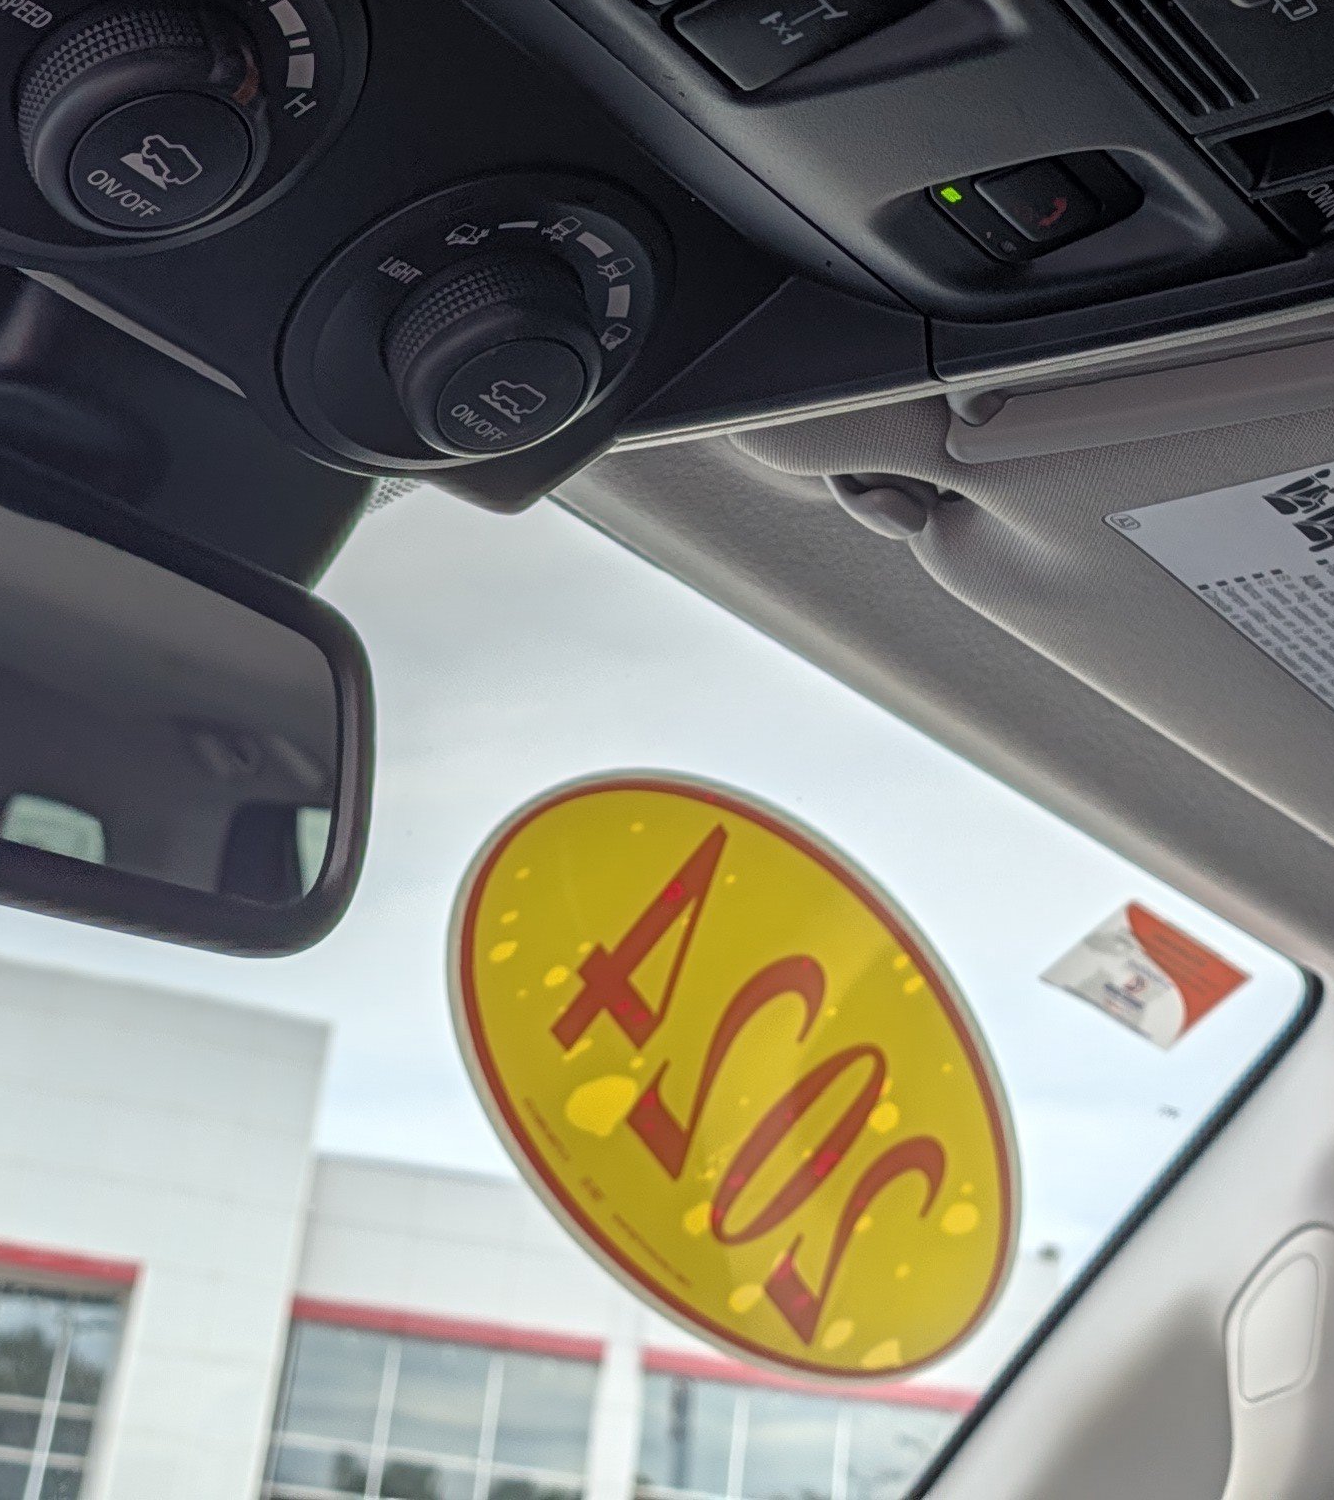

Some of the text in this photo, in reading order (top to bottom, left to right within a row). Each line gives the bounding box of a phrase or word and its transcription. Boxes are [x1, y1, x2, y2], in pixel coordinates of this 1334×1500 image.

[282, 93, 318, 119] H
[87, 168, 161, 222] ON/OFF
[378, 255, 424, 286] LIGHT
[450, 401, 509, 444] ON/OFF
